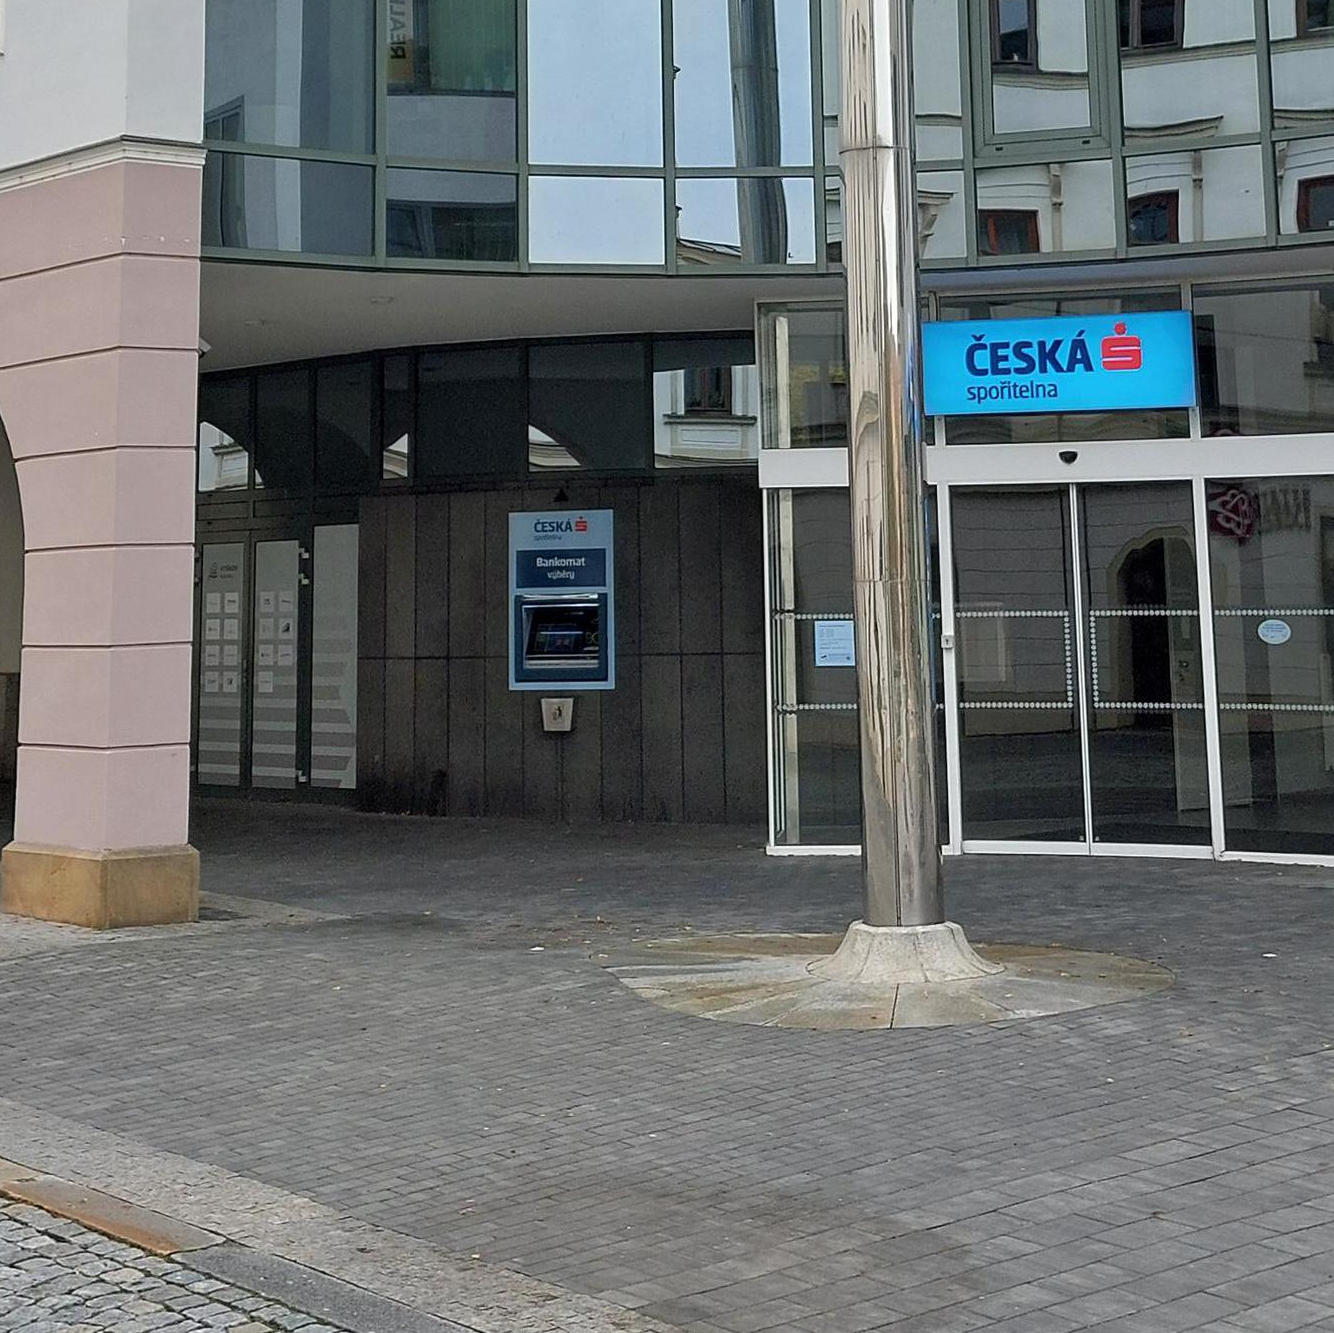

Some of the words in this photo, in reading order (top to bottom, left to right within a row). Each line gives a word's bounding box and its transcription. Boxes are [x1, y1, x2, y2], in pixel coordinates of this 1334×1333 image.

[965, 330, 1094, 377] ČESKÁ
[966, 380, 1058, 404] spořitelna
[533, 518, 573, 533] ČESKÁ
[536, 557, 585, 567] Bankomat
[547, 570, 575, 579] výběry
